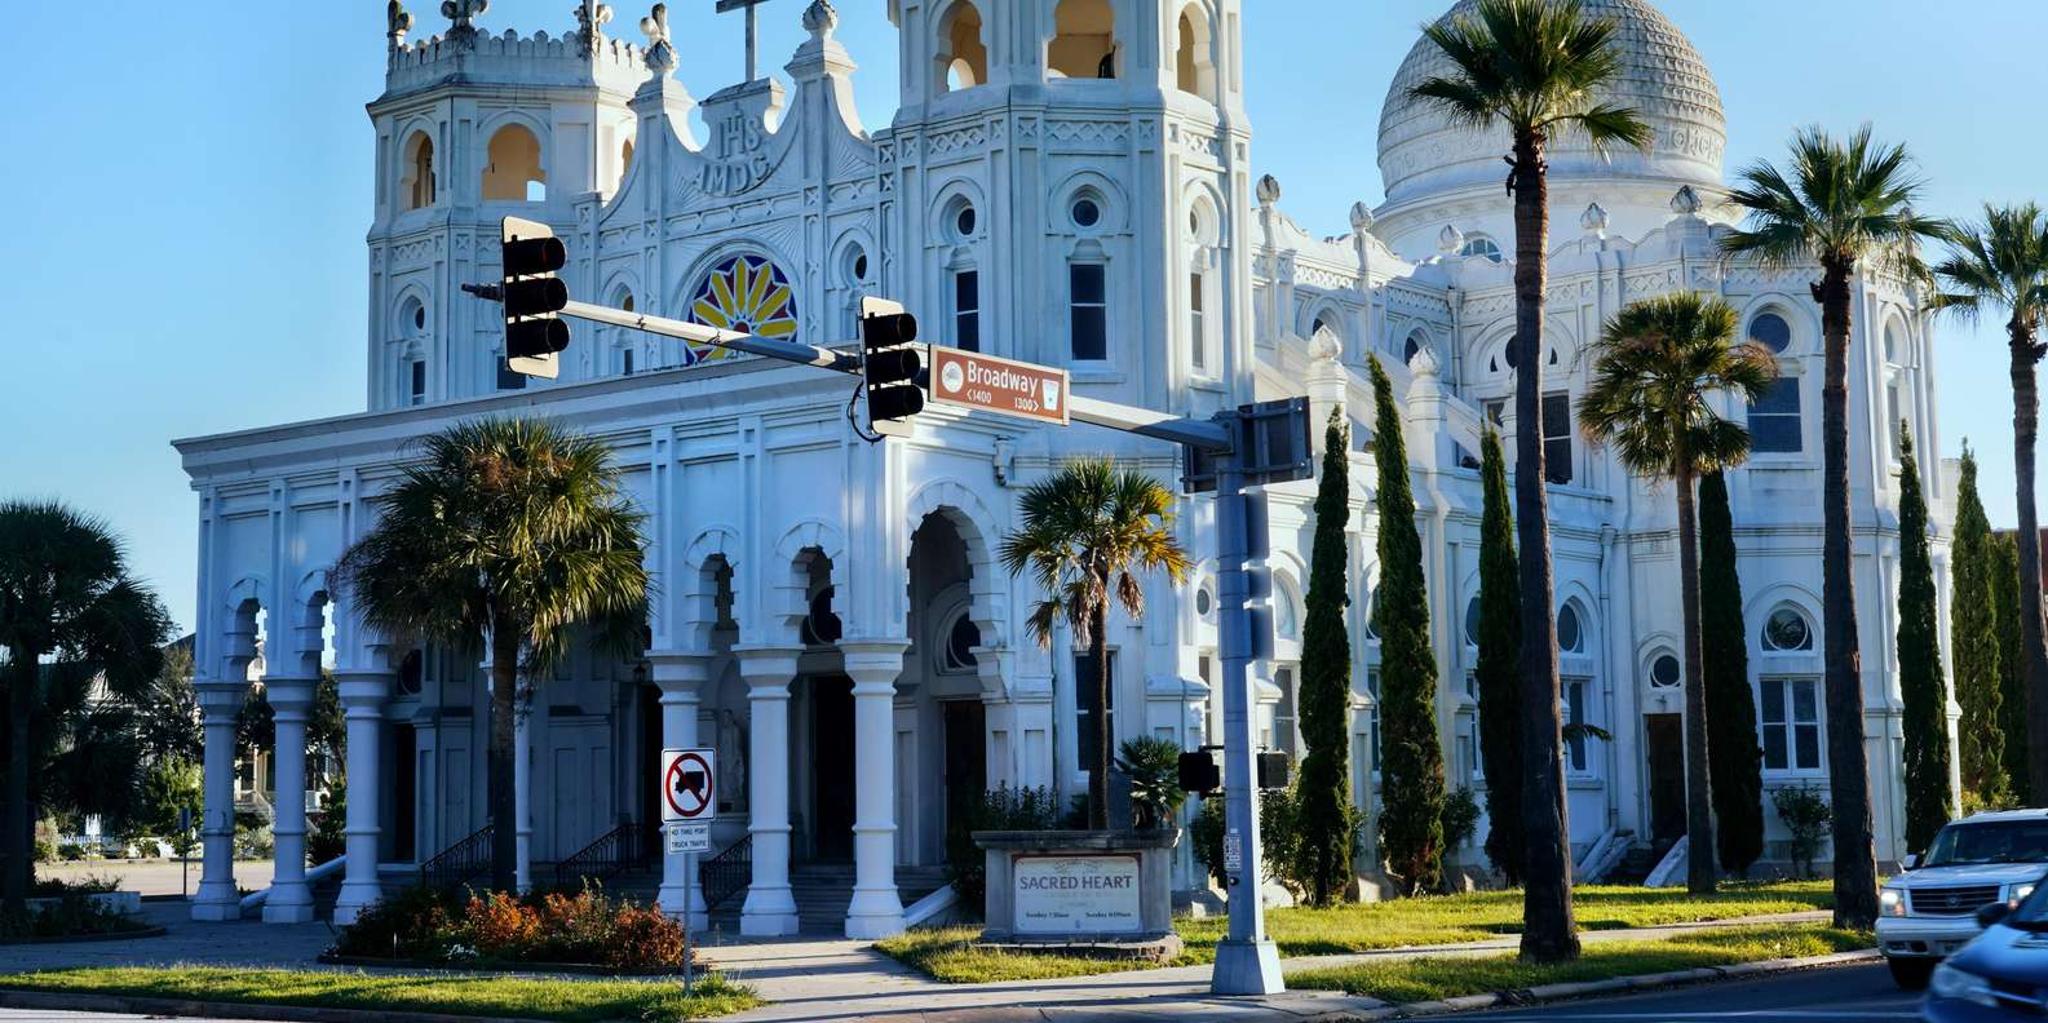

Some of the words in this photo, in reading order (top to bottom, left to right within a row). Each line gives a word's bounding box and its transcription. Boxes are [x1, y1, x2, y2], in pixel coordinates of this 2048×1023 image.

[716, 114, 763, 160] IHS
[966, 360, 1039, 398] Broadway
[1020, 875, 1079, 890] SACRED
[1082, 874, 1133, 889] HEART
